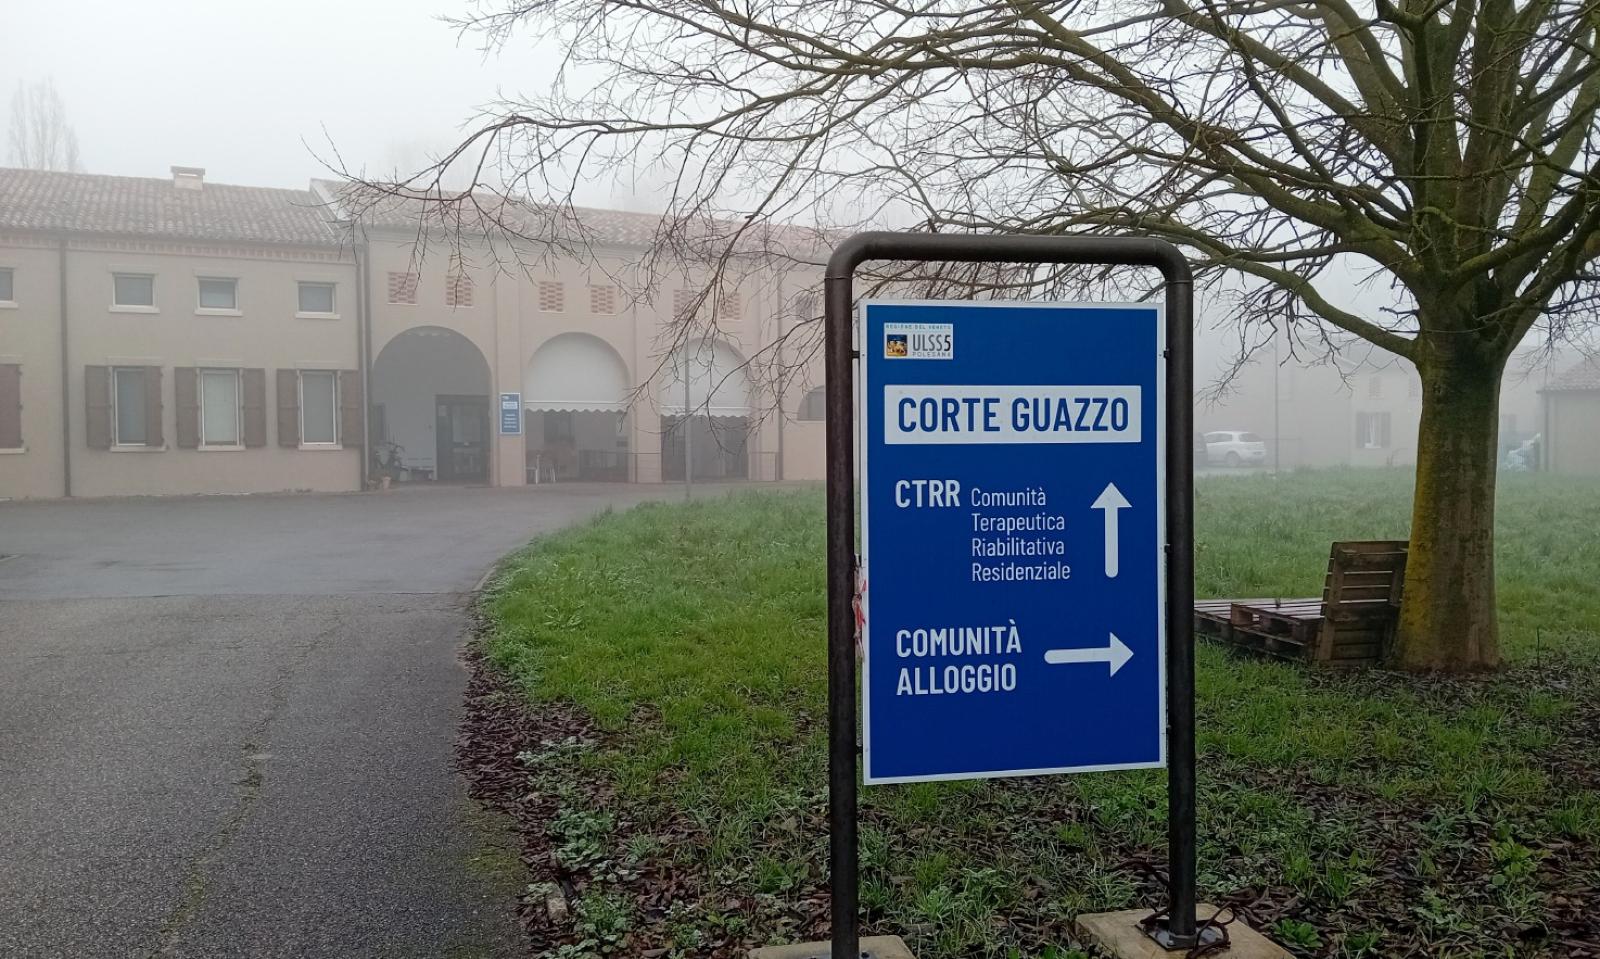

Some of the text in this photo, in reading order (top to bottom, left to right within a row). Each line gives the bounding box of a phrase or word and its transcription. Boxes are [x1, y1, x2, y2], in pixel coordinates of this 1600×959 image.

[912, 334, 951, 351] ULSS5
[898, 397, 1129, 432] CORTE GUAZZO
[895, 479, 1046, 508] CTRR Comunità
[971, 512, 1066, 536] Terapeutica
[972, 537, 1065, 557] Riabilitativa
[972, 561, 1071, 582] Residenziale
[896, 619, 1022, 658] COMUNITÀ
[896, 663, 1017, 696] ALLOGGIO
